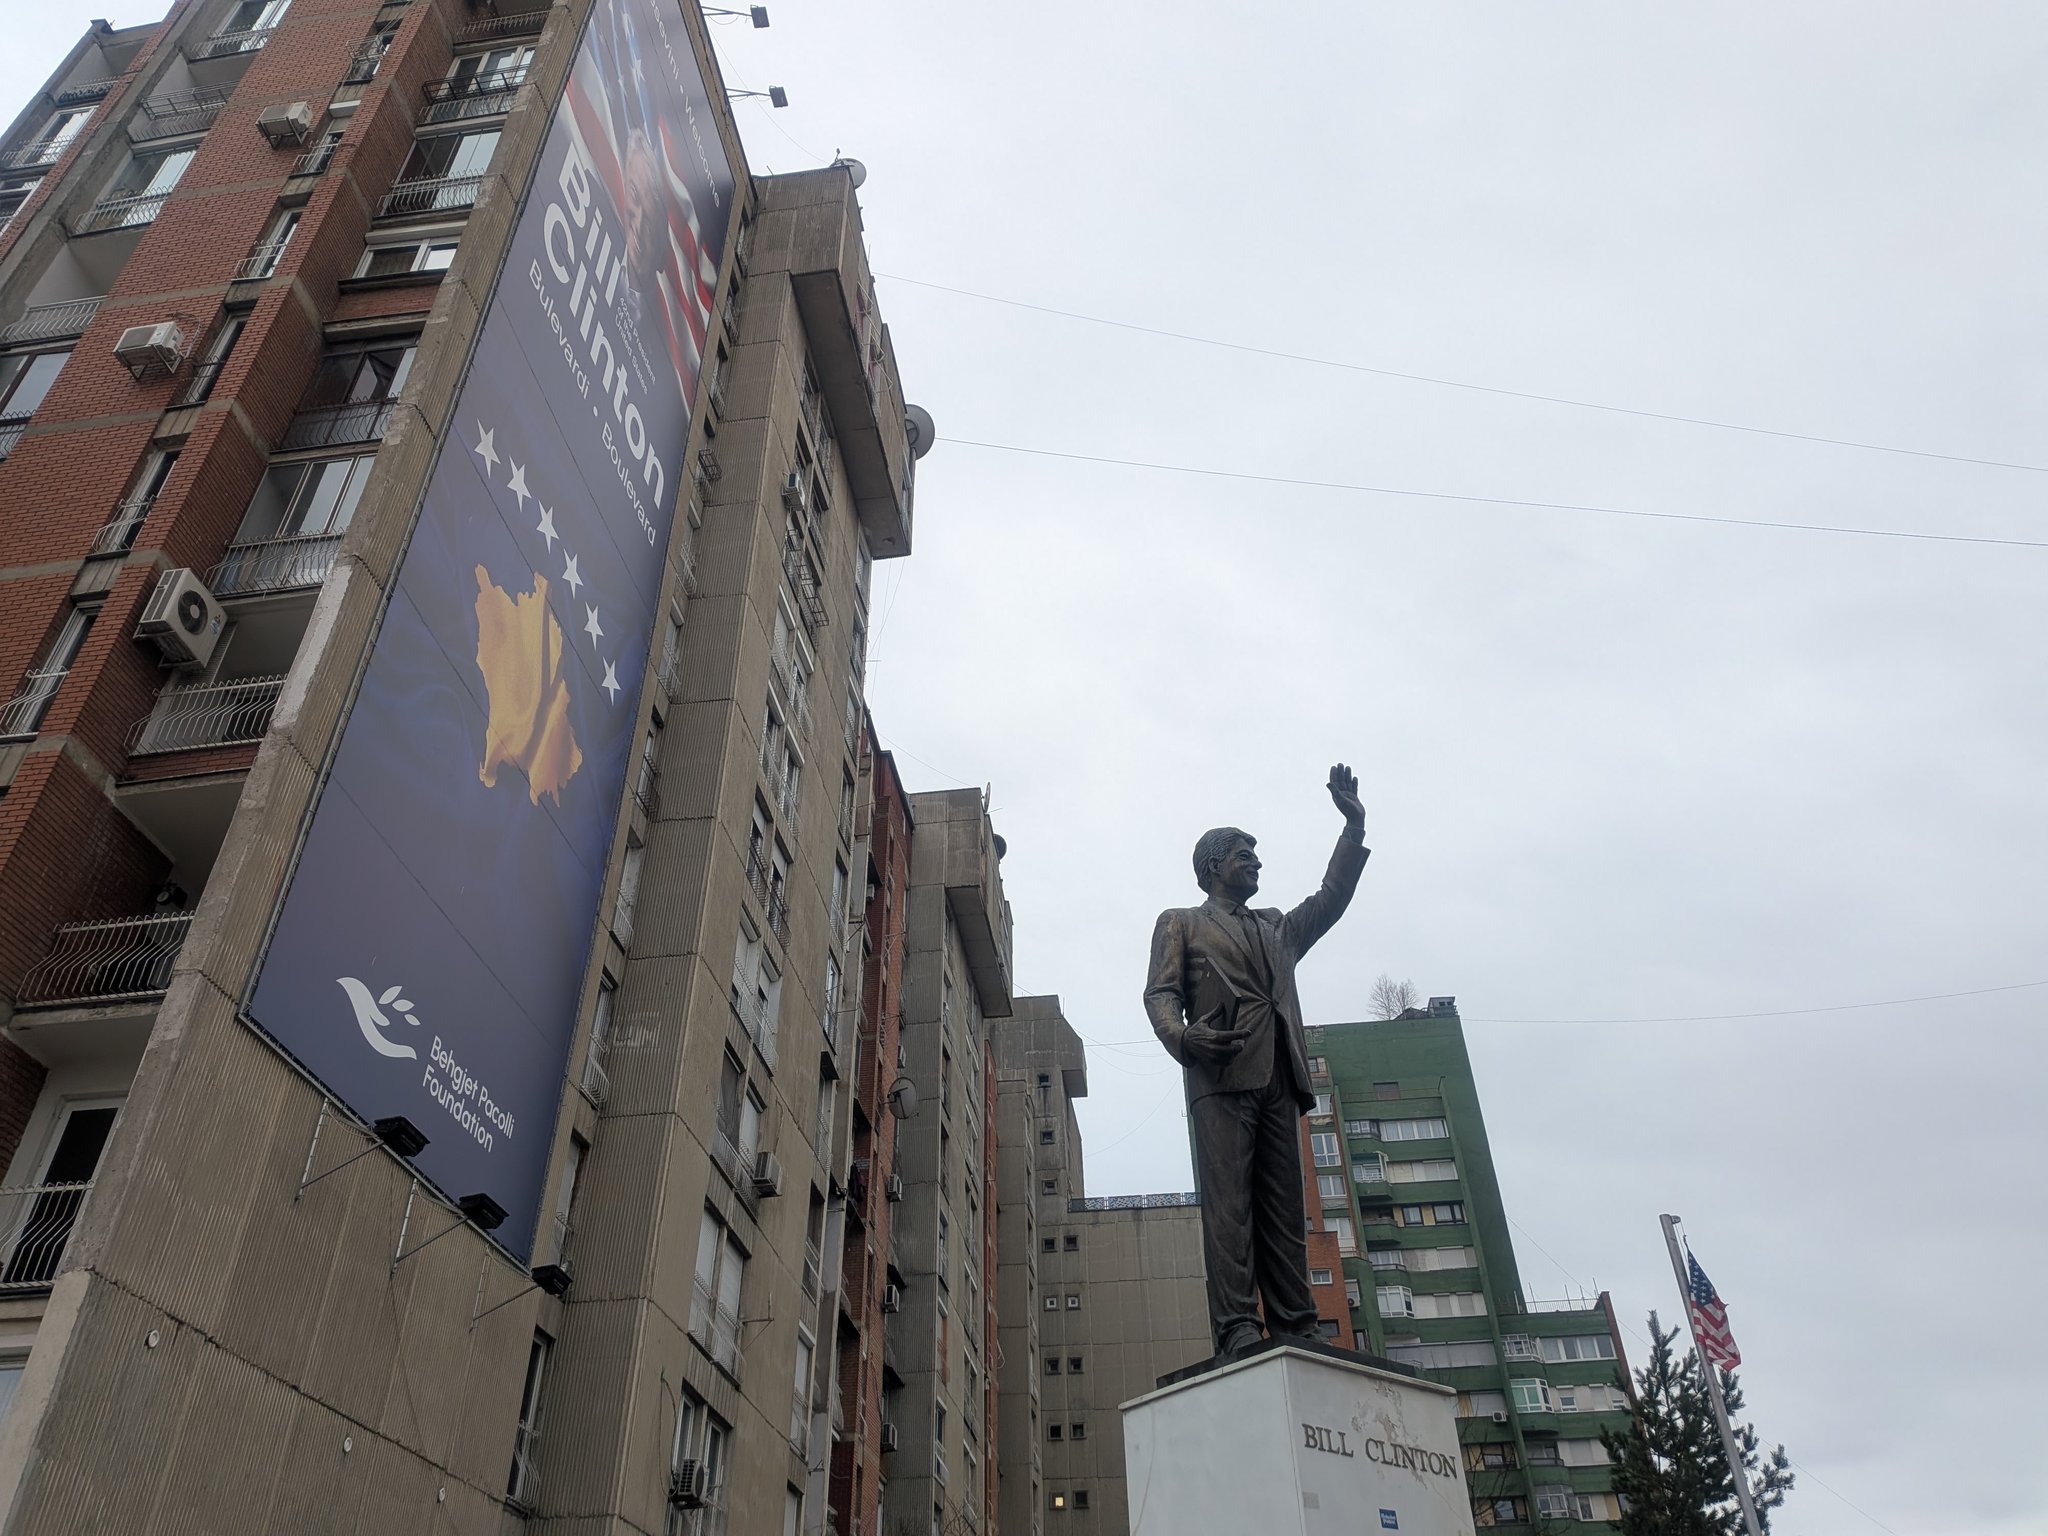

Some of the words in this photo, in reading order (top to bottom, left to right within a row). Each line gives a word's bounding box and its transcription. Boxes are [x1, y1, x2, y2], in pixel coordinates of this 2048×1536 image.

[684, 96, 720, 208] Welcome
[558, 141, 622, 308] Bill
[543, 202, 665, 510] Clinton
[615, 314, 632, 356] United
[631, 355, 648, 395] States
[617, 306, 624, 320] of
[623, 319, 632, 341] the
[620, 298, 633, 329] 42nd
[633, 327, 656, 385] President
[529, 258, 590, 400] Bulevardi
[601, 421, 657, 547] Boulevard
[422, 1064, 493, 1153] Foundation
[430, 1035, 478, 1100] Behgjet
[477, 1086, 516, 1139] Pacolli
[1301, 1423, 1354, 1458] BILL
[1365, 1438, 1458, 1480] CLINTON
